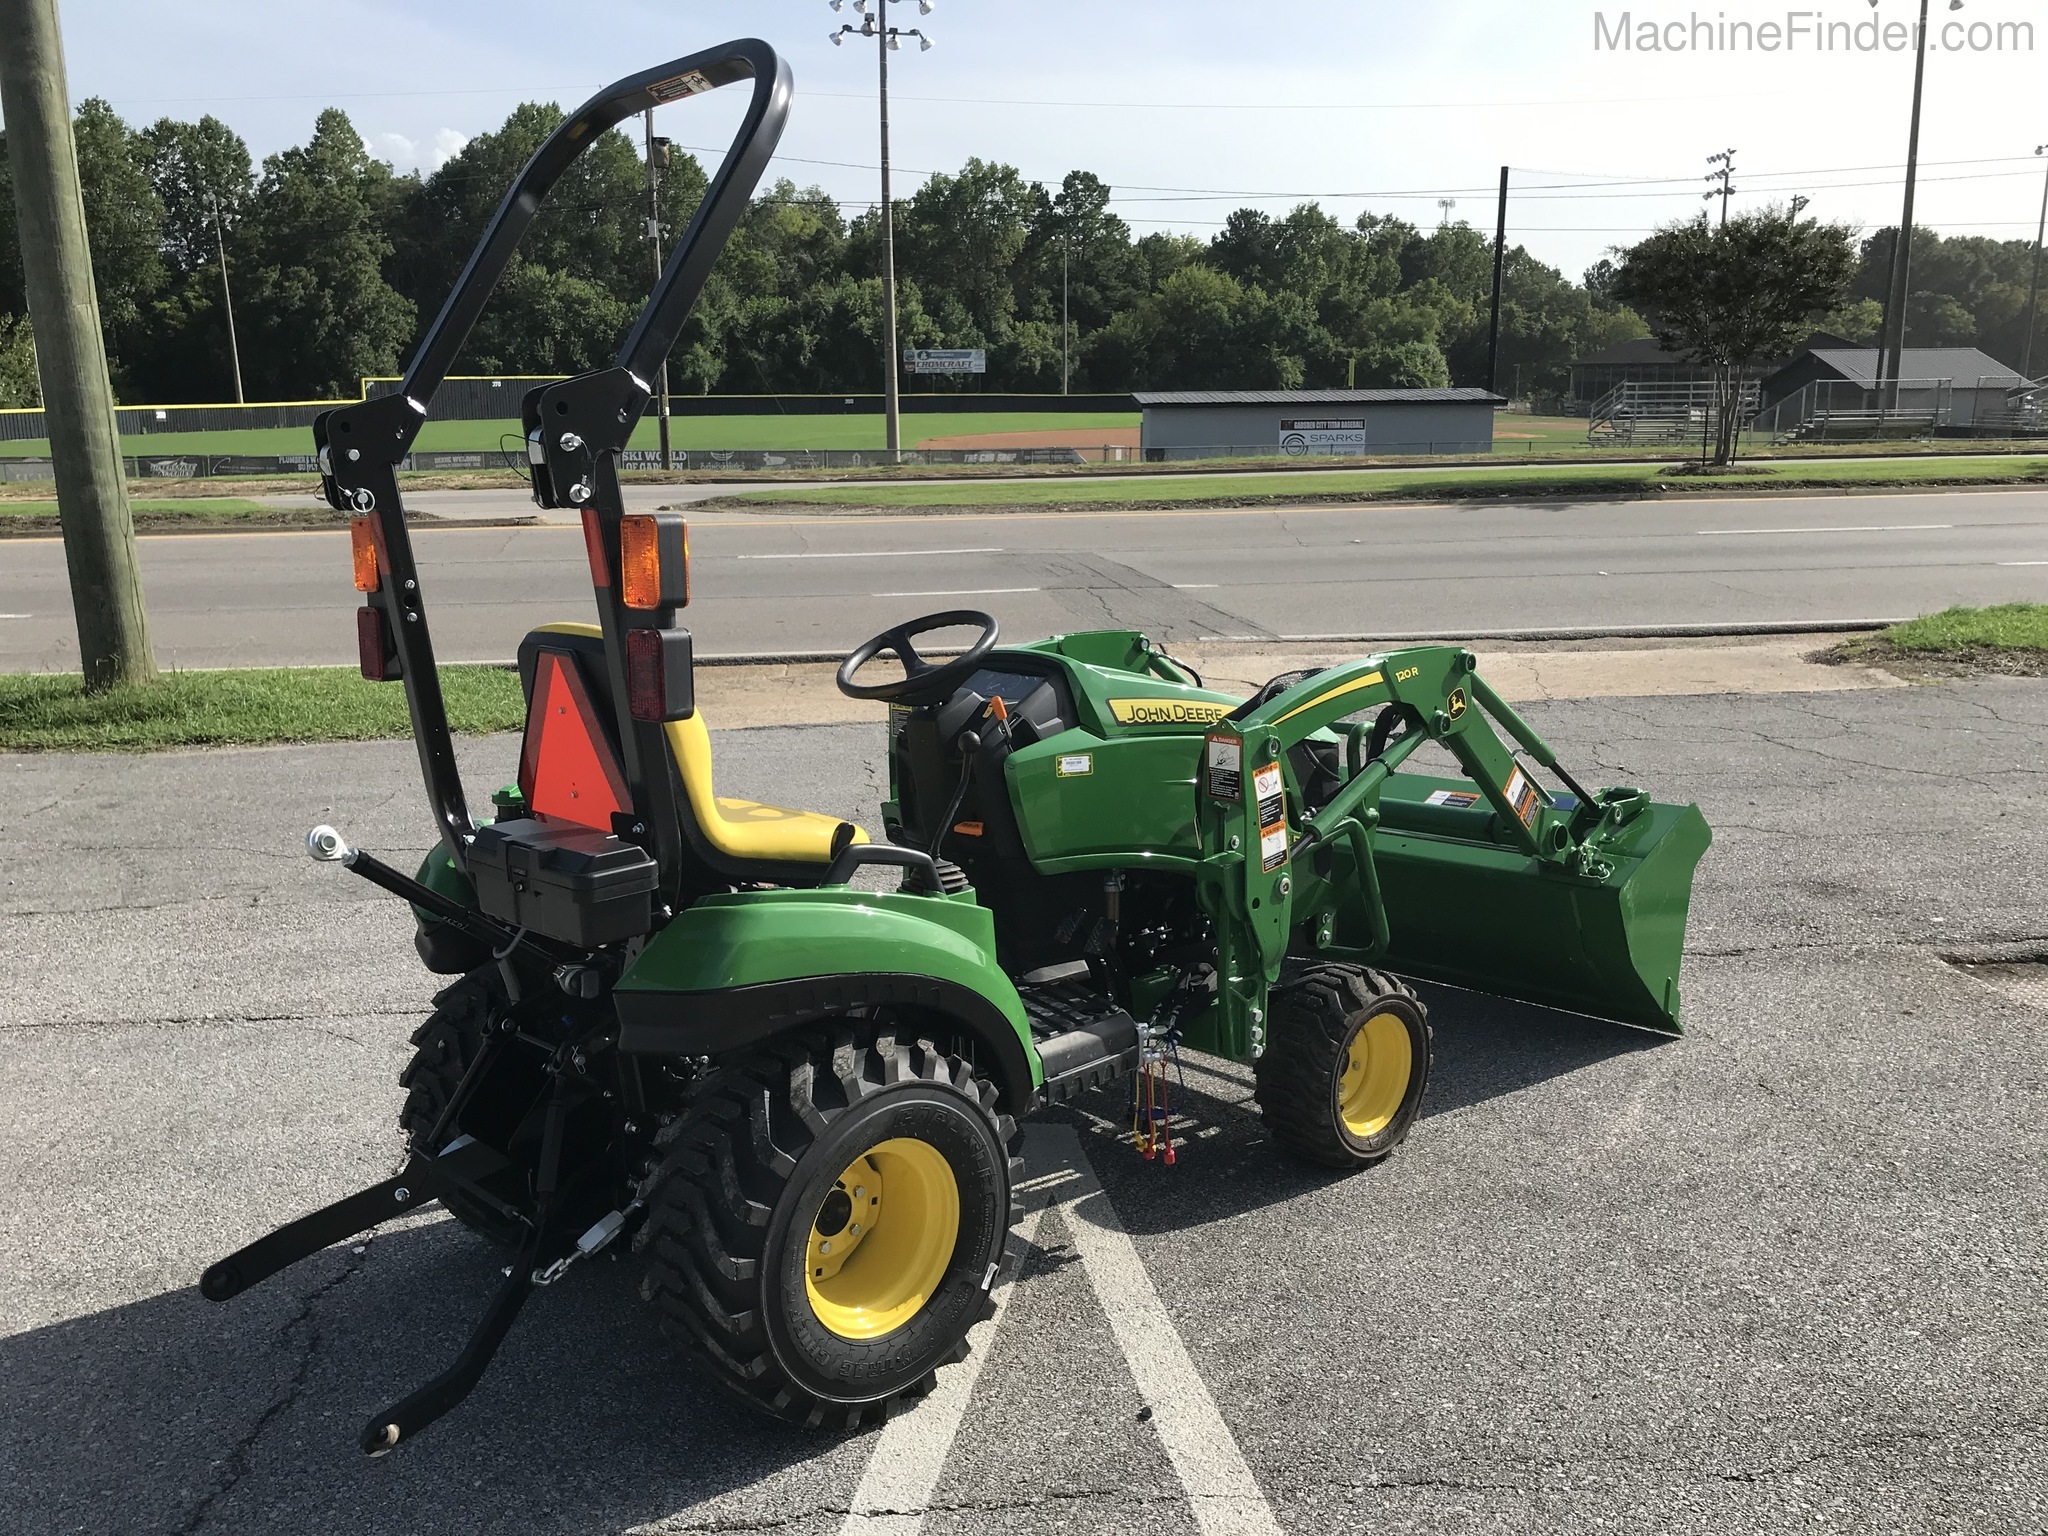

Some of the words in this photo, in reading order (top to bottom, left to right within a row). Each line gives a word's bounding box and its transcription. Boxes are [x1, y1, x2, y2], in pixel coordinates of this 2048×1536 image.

[1316, 421, 1327, 429] CITY
[1341, 421, 1364, 429] BASEBALL
[1310, 434, 1364, 443] SPARKS
[623, 451, 642, 461] SKI
[644, 451, 687, 461] WOLD
[1127, 705, 1171, 721] JOHN
[1173, 704, 1223, 721] DEERE
[1218, 737, 1238, 745] DANGER
